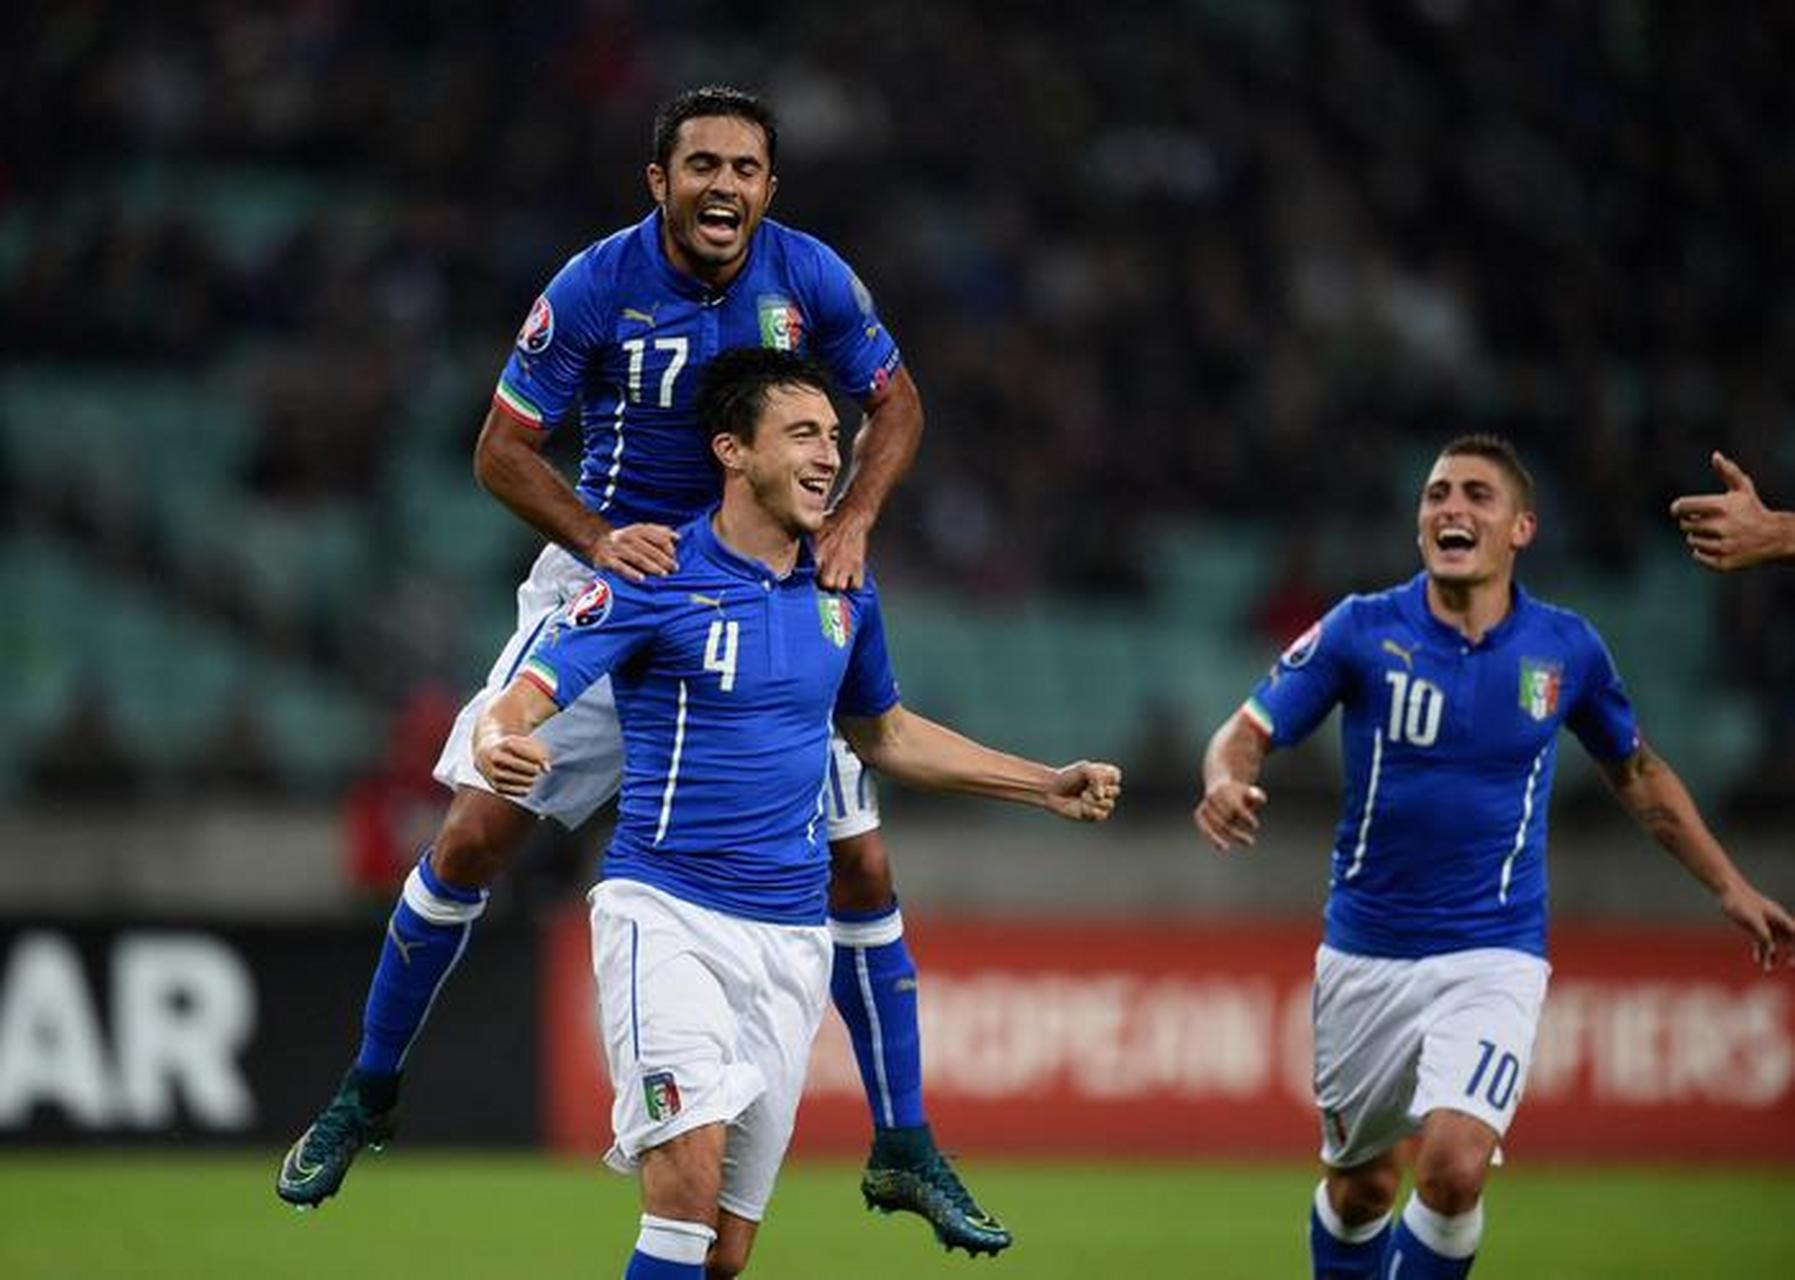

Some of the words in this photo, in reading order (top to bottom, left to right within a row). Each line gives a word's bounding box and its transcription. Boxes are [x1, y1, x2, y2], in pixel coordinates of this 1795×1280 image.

[622, 337, 688, 408] 17
[704, 621, 739, 692] 4
[1386, 670, 1444, 746] 10
[0, 930, 256, 1130] AR
[1465, 1040, 1519, 1111] 10
